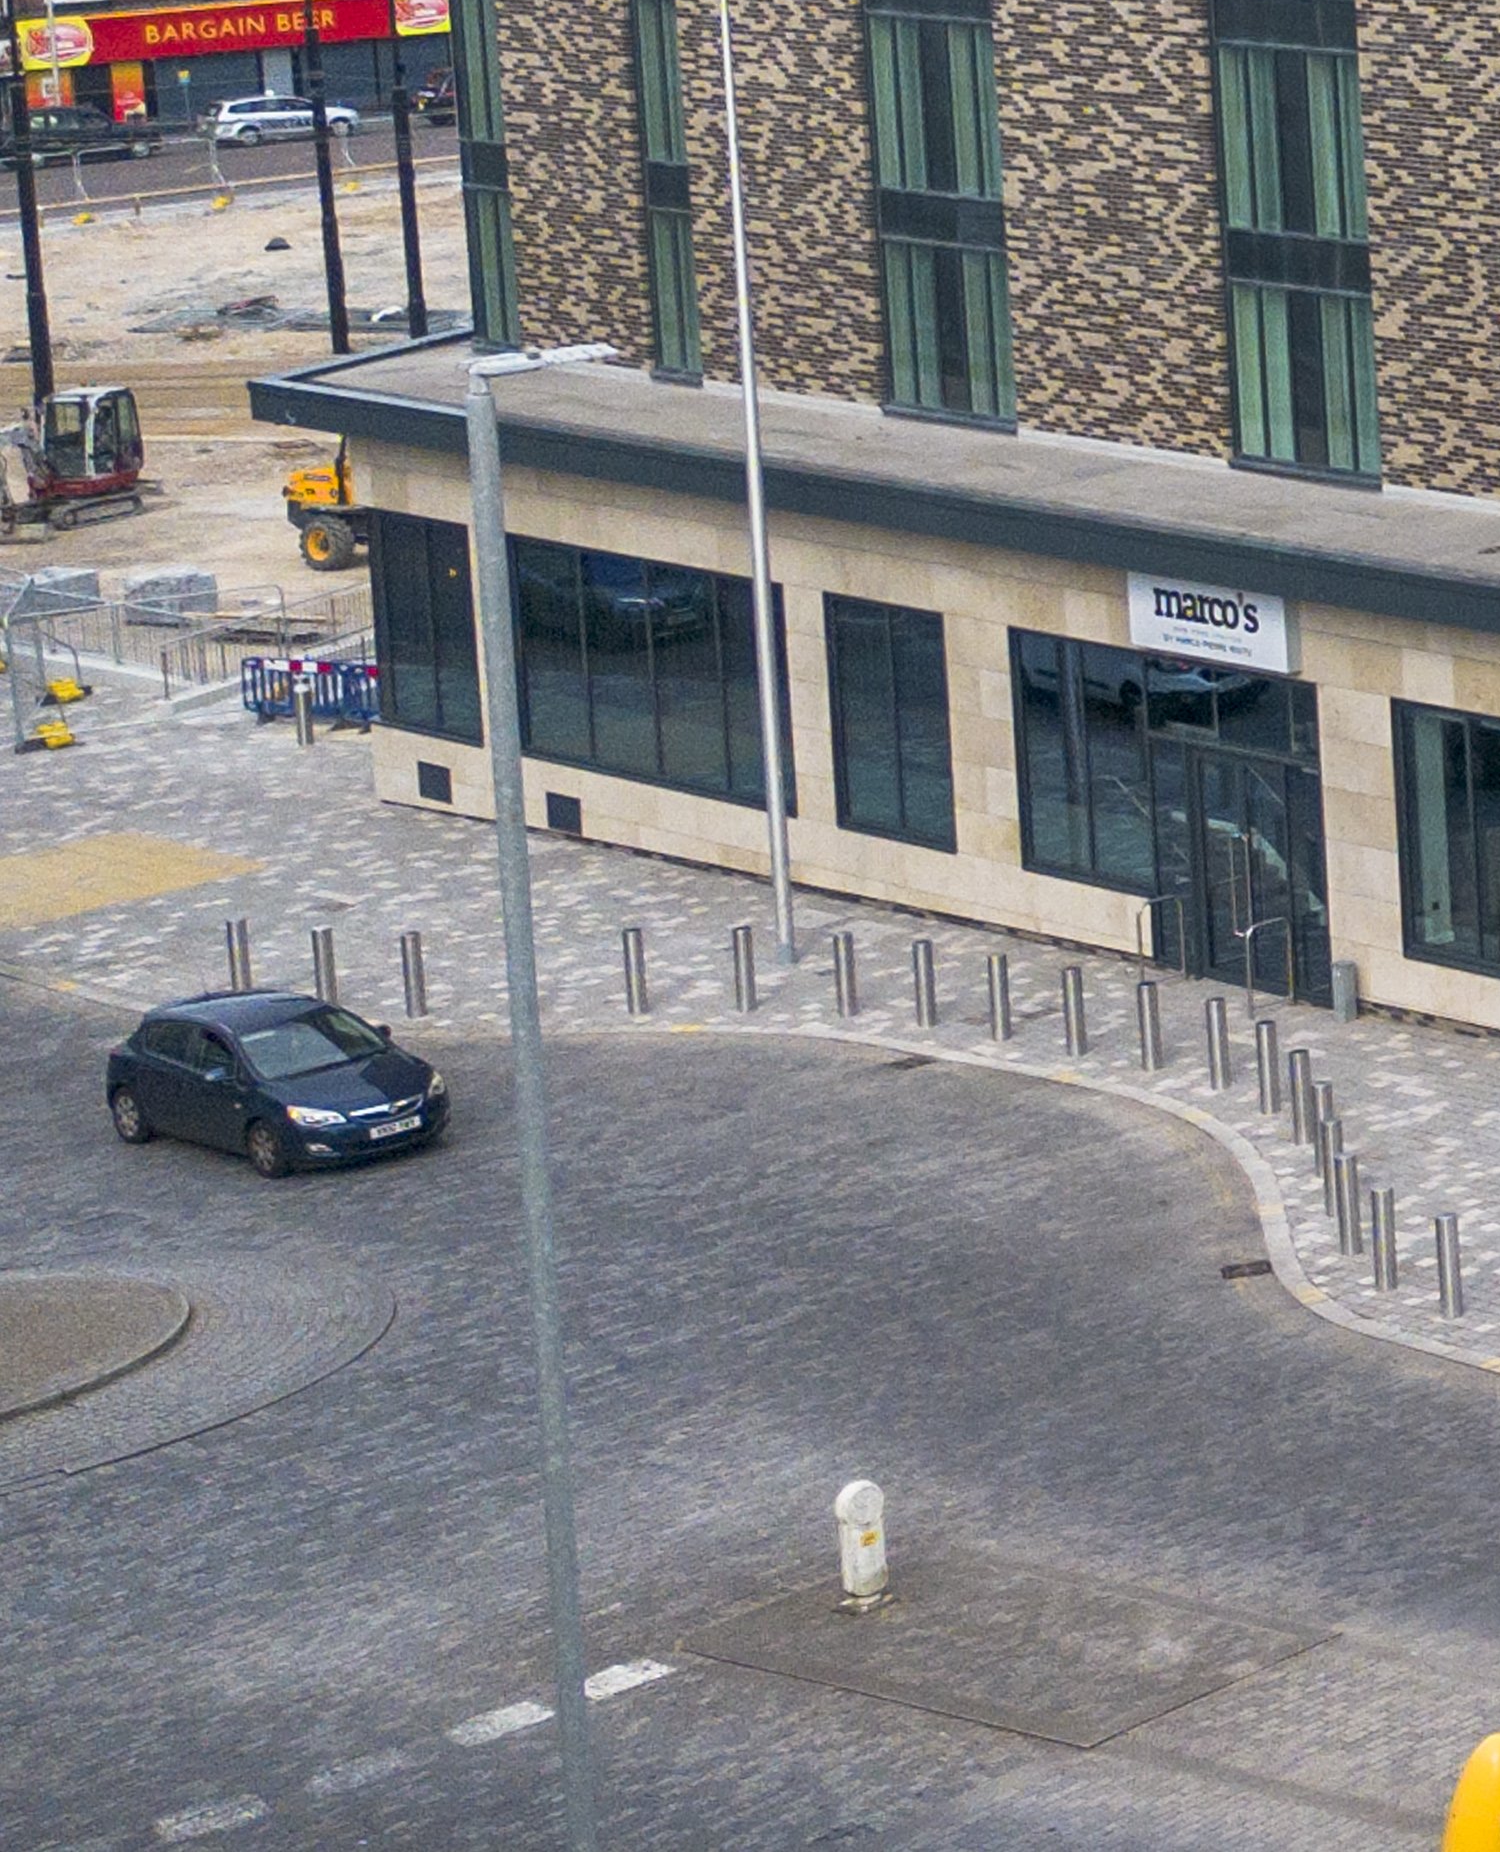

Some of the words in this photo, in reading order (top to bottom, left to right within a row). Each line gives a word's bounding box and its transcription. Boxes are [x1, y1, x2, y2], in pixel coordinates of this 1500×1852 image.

[145, 14, 266, 44] BARGAIN
[276, 9, 335, 33] BEER
[1153, 587, 1260, 633] marco's
